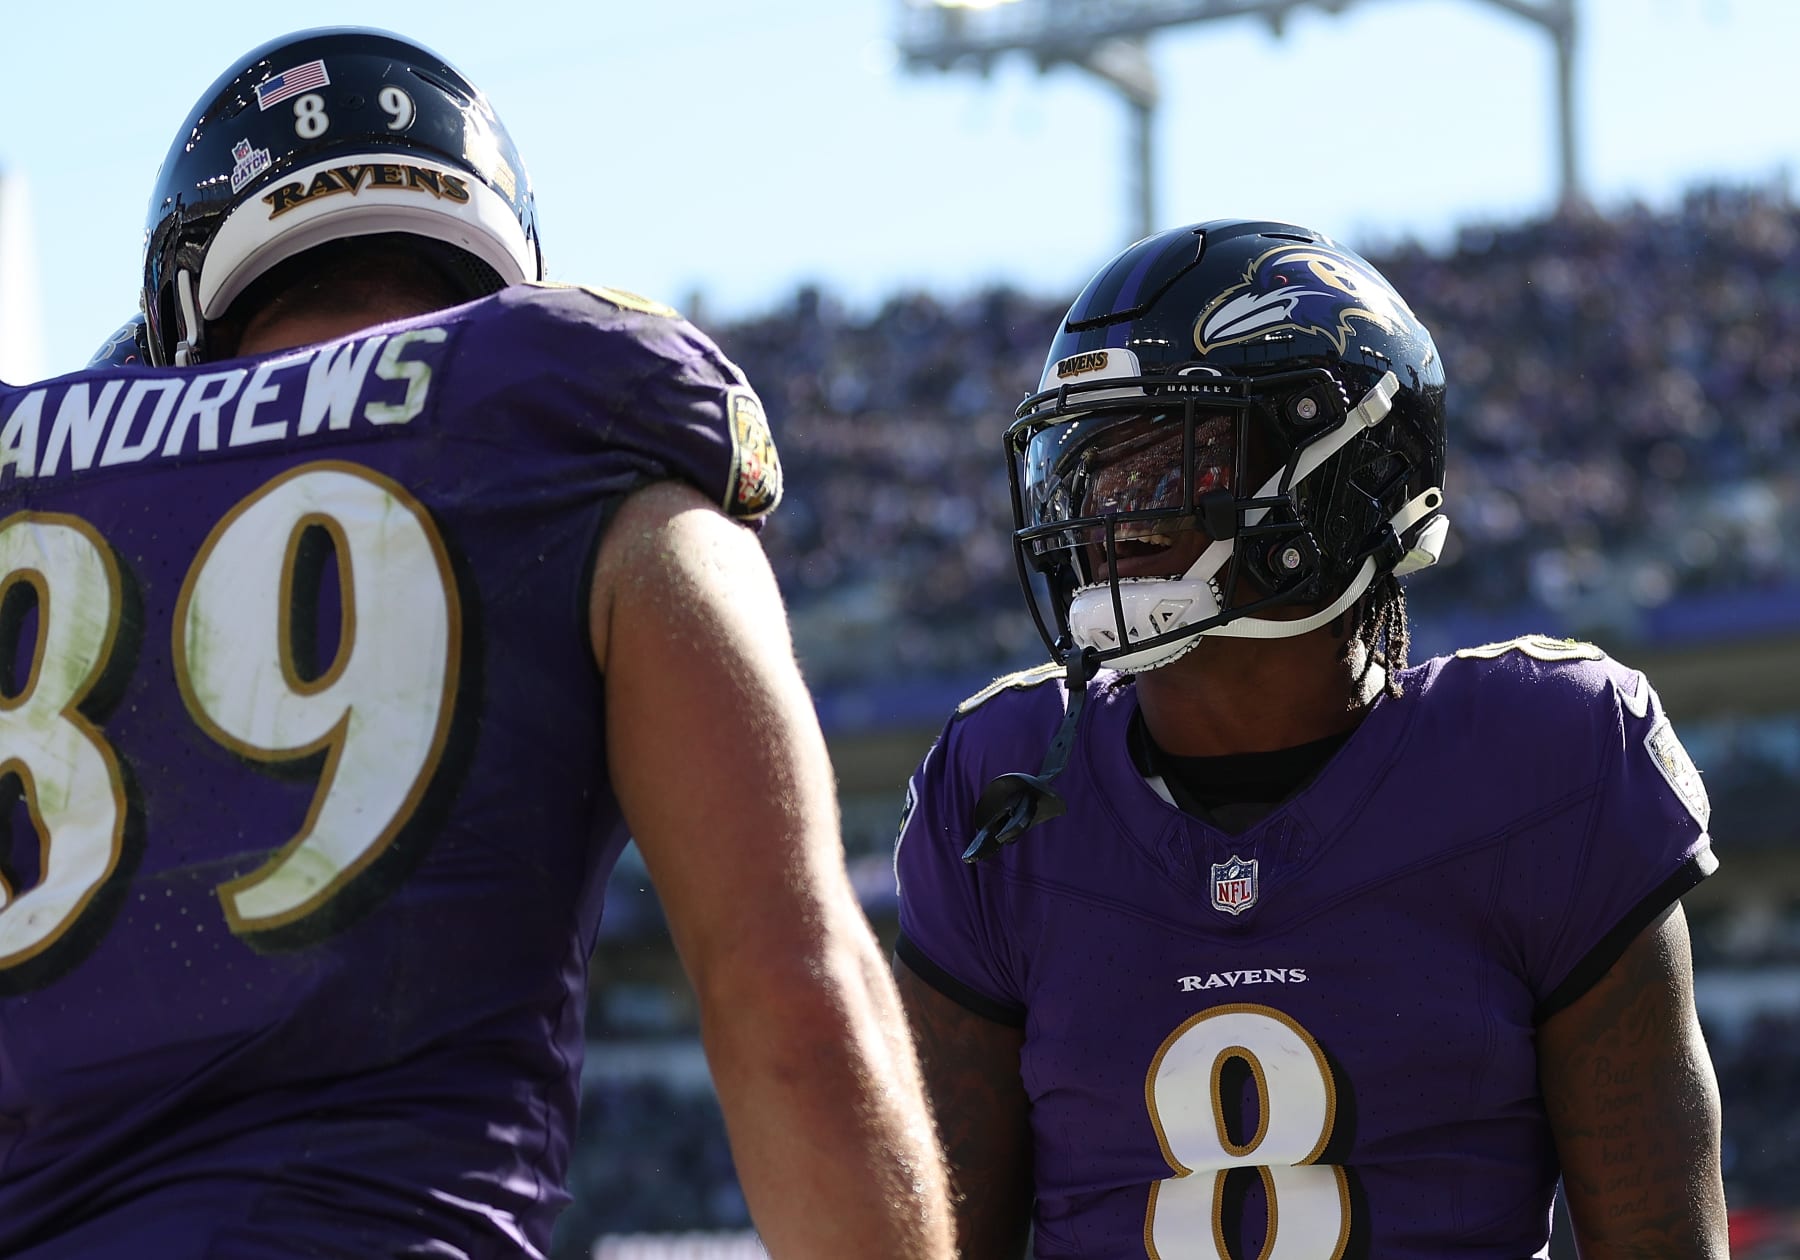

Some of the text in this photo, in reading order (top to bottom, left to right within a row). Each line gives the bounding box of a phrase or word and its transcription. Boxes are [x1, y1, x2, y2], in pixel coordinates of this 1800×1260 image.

[293, 86, 416, 139] 8 9
[232, 150, 269, 186] CATCH
[262, 163, 471, 220] RAVENS
[1056, 351, 1109, 379] RAVENS
[0, 327, 448, 482] ANDREWS
[1167, 384, 1232, 394] OAKLEY
[1216, 877, 1251, 905] NFL
[1177, 967, 1308, 992] RAVENS
[1144, 1002, 1352, 1260] 8
